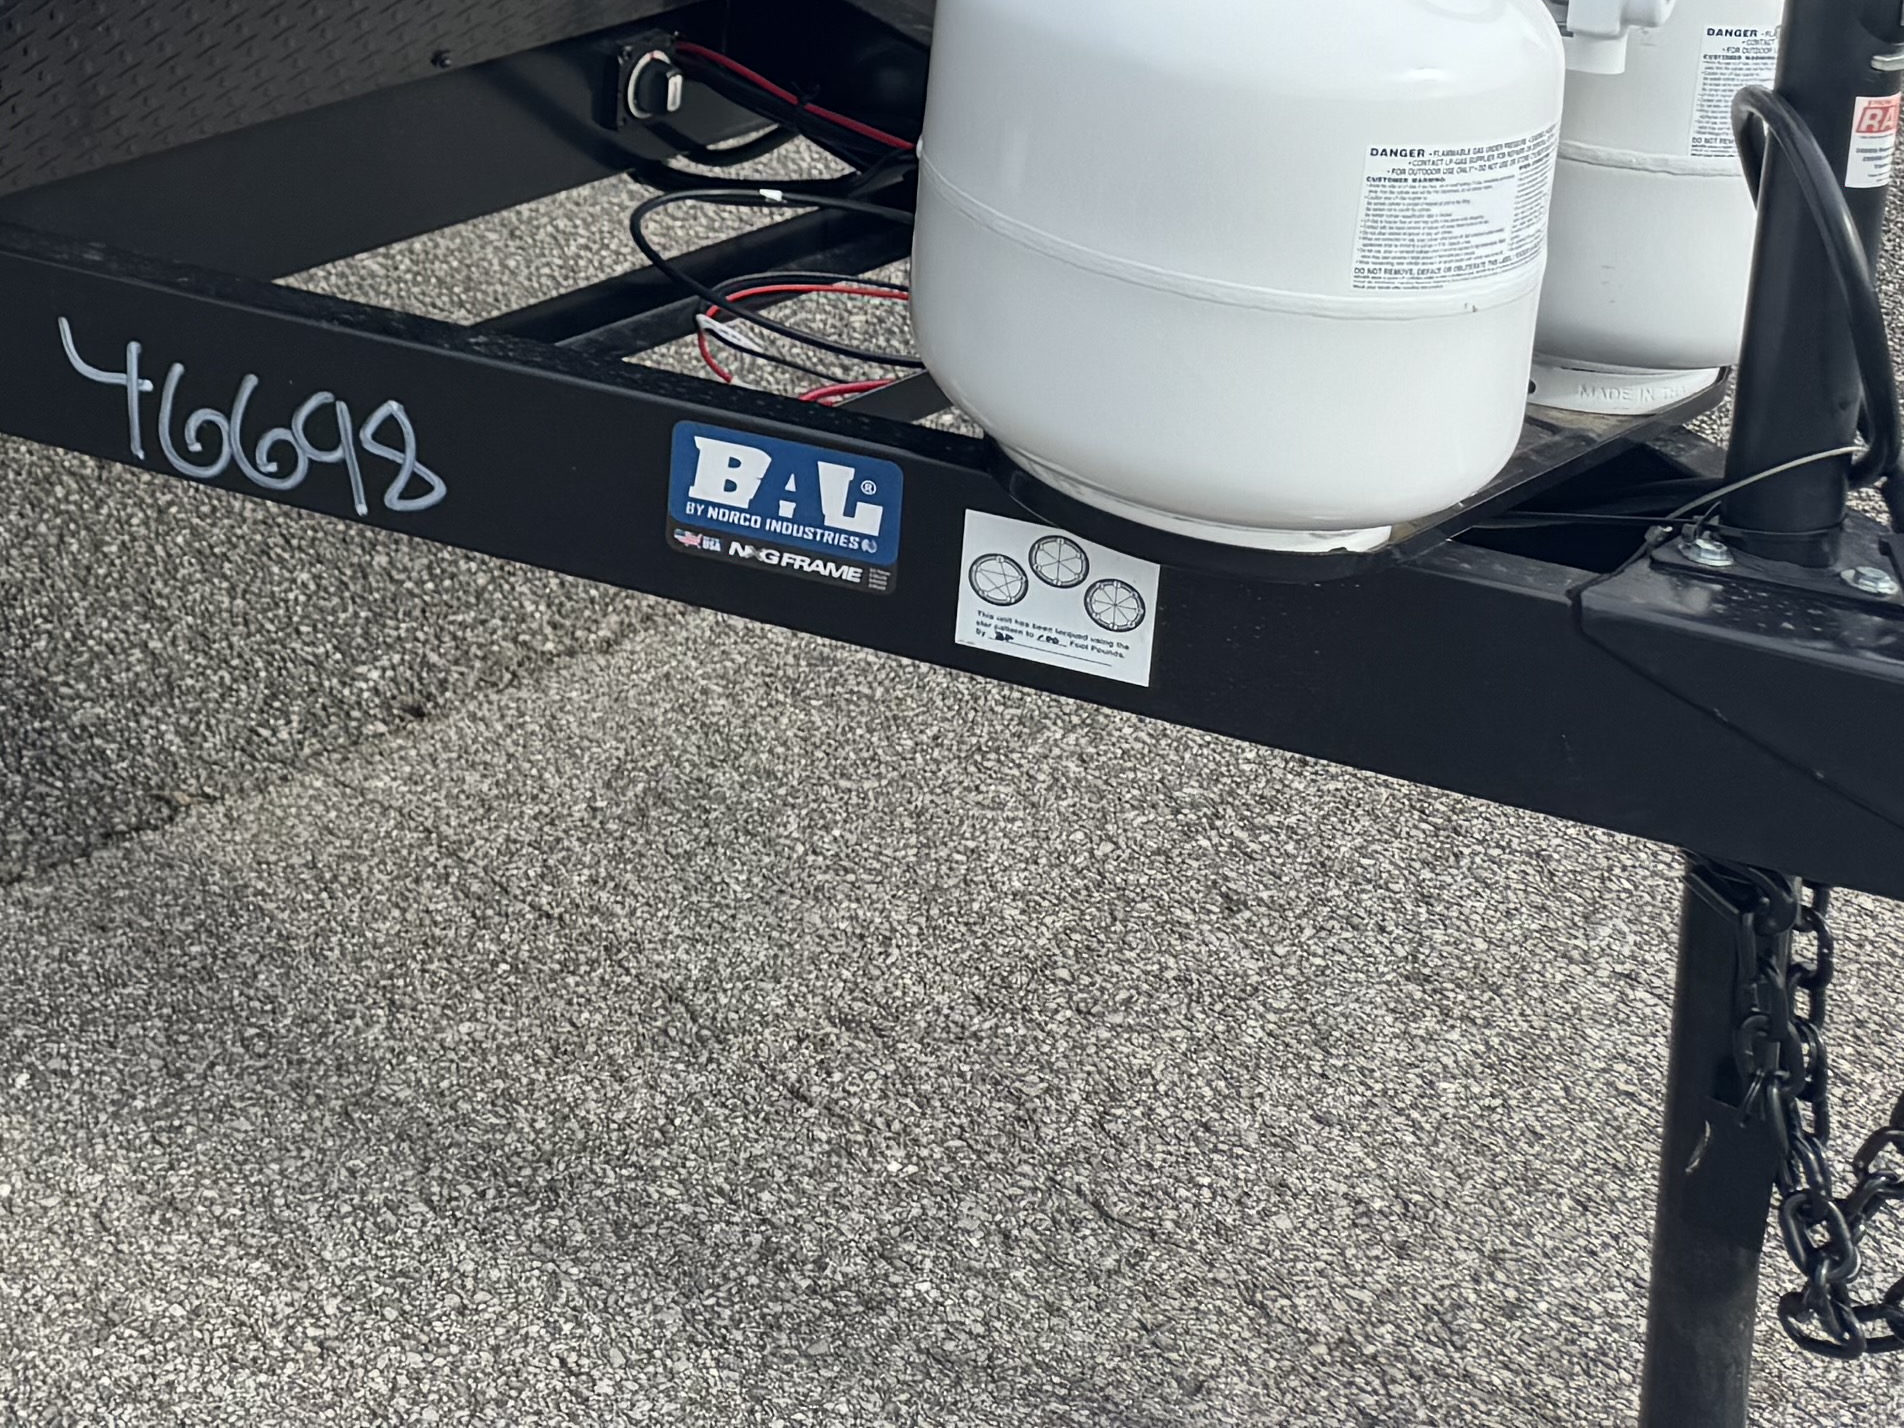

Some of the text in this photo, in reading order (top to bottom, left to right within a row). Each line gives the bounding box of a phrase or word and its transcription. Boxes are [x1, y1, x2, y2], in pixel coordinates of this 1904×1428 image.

[1706, 27, 1759, 37] DANGER
[1370, 147, 1425, 158] DANGER
[58, 316, 448, 516] 46698
[688, 435, 884, 537] BAL
[685, 501, 860, 551] BY NORCO INDUSTRIES
[977, 610, 994, 620] This
